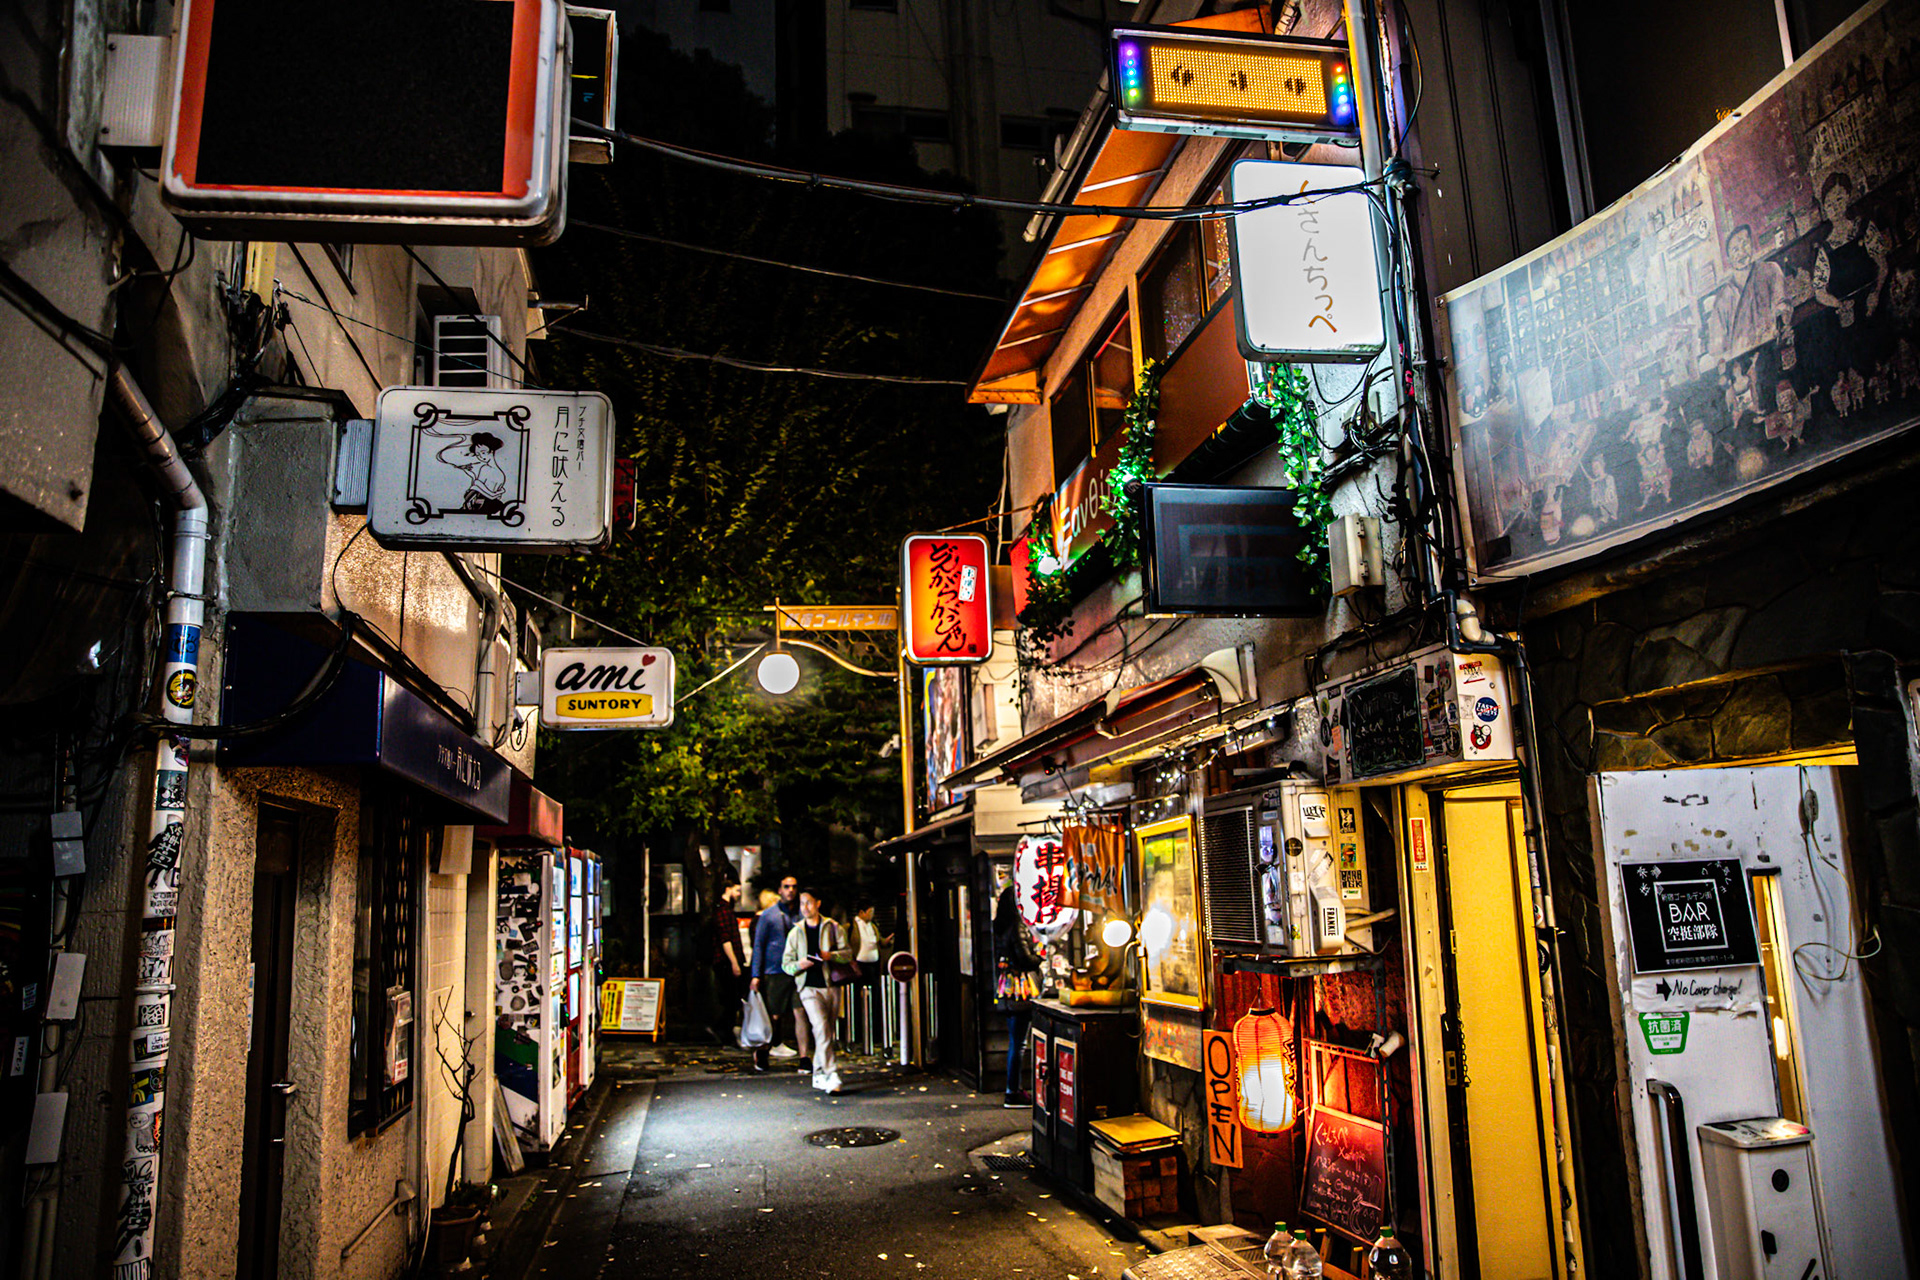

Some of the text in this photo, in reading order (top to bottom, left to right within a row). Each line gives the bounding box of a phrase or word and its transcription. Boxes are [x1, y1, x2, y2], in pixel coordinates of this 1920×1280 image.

[551, 406, 570, 527] 月に吠える
[555, 662, 647, 691] ami
[568, 699, 643, 710] SUNTORY
[1326, 907, 1336, 936] FRANKIE
[1669, 902, 1711, 923] BAR
[1668, 924, 1719, 941] 空挺部隊
[1672, 979, 1688, 996] No
[1648, 1020, 1681, 1034] 抗菌済
[1208, 1036, 1236, 1163] OPEN
